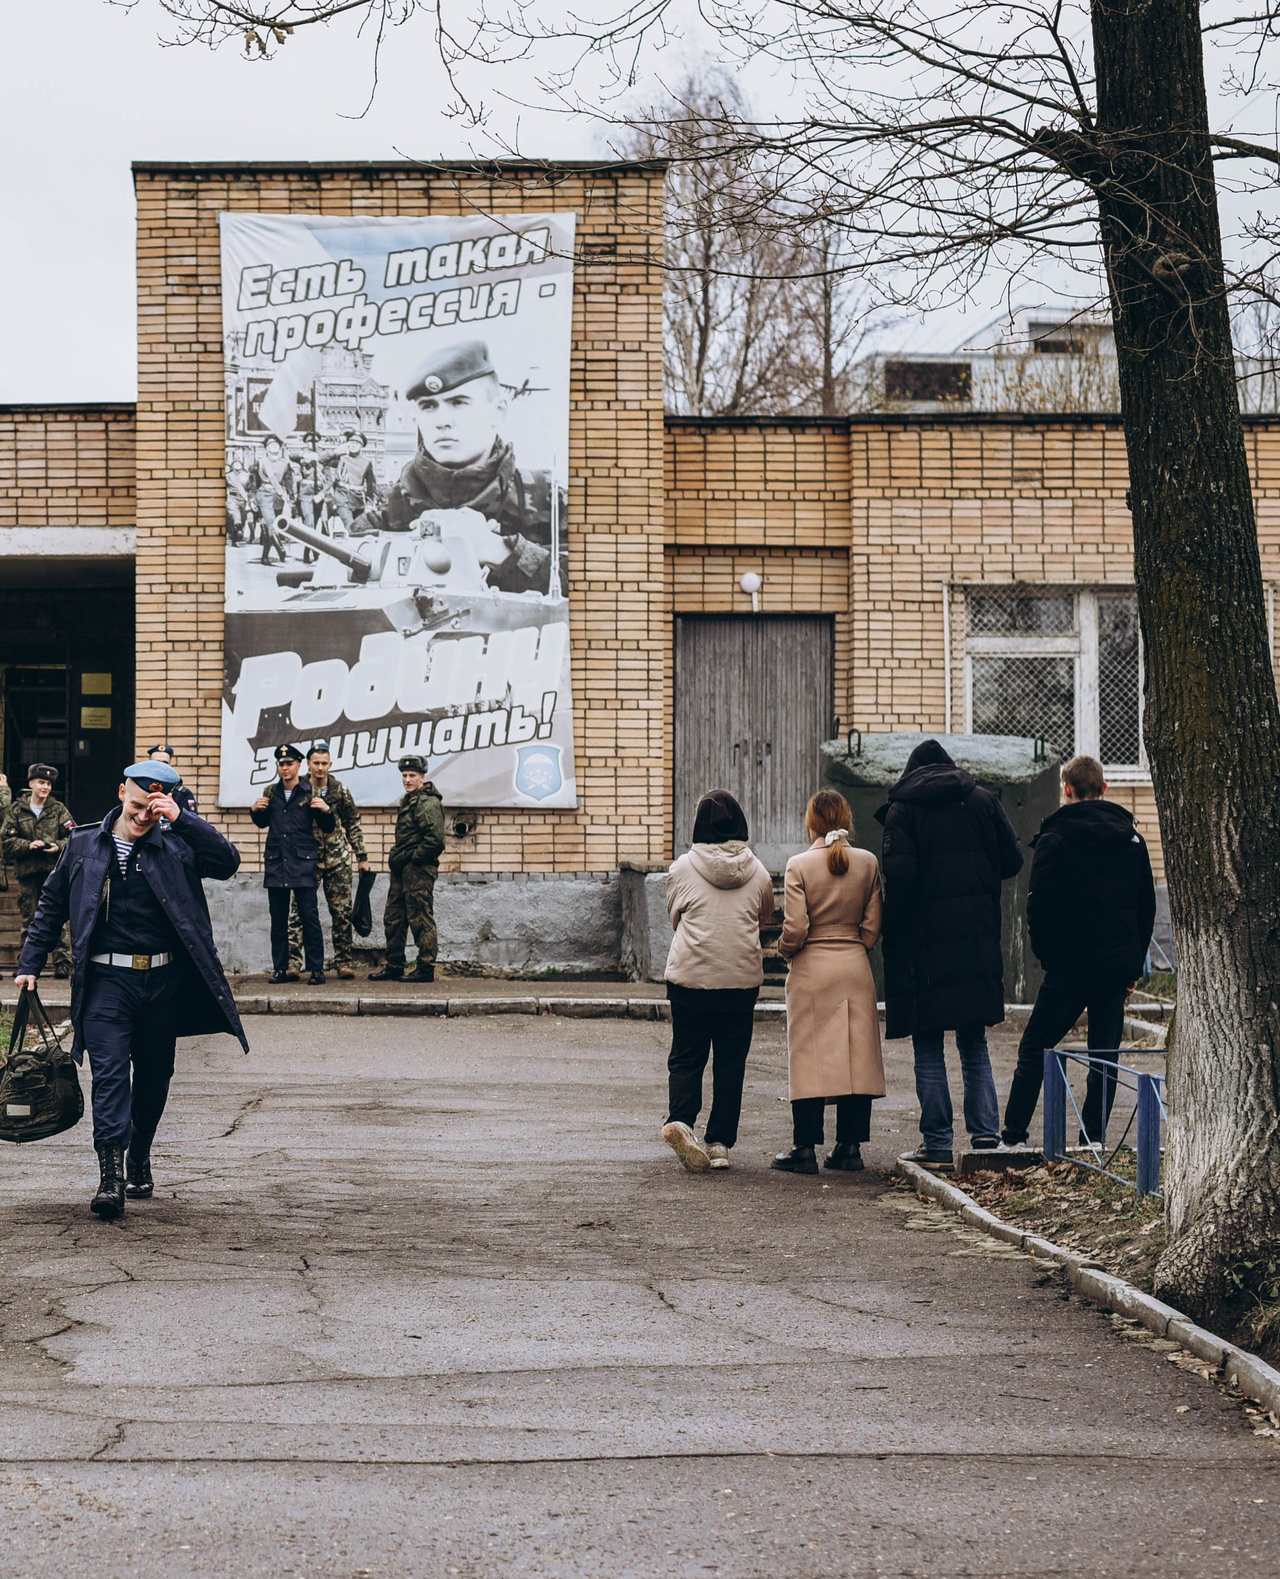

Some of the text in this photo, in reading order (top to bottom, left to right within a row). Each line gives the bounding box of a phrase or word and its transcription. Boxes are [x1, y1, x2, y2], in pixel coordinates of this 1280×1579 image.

[238, 227, 550, 311] Есть такая
[243, 278, 522, 363] профессия
[232, 622, 568, 738] Родину
